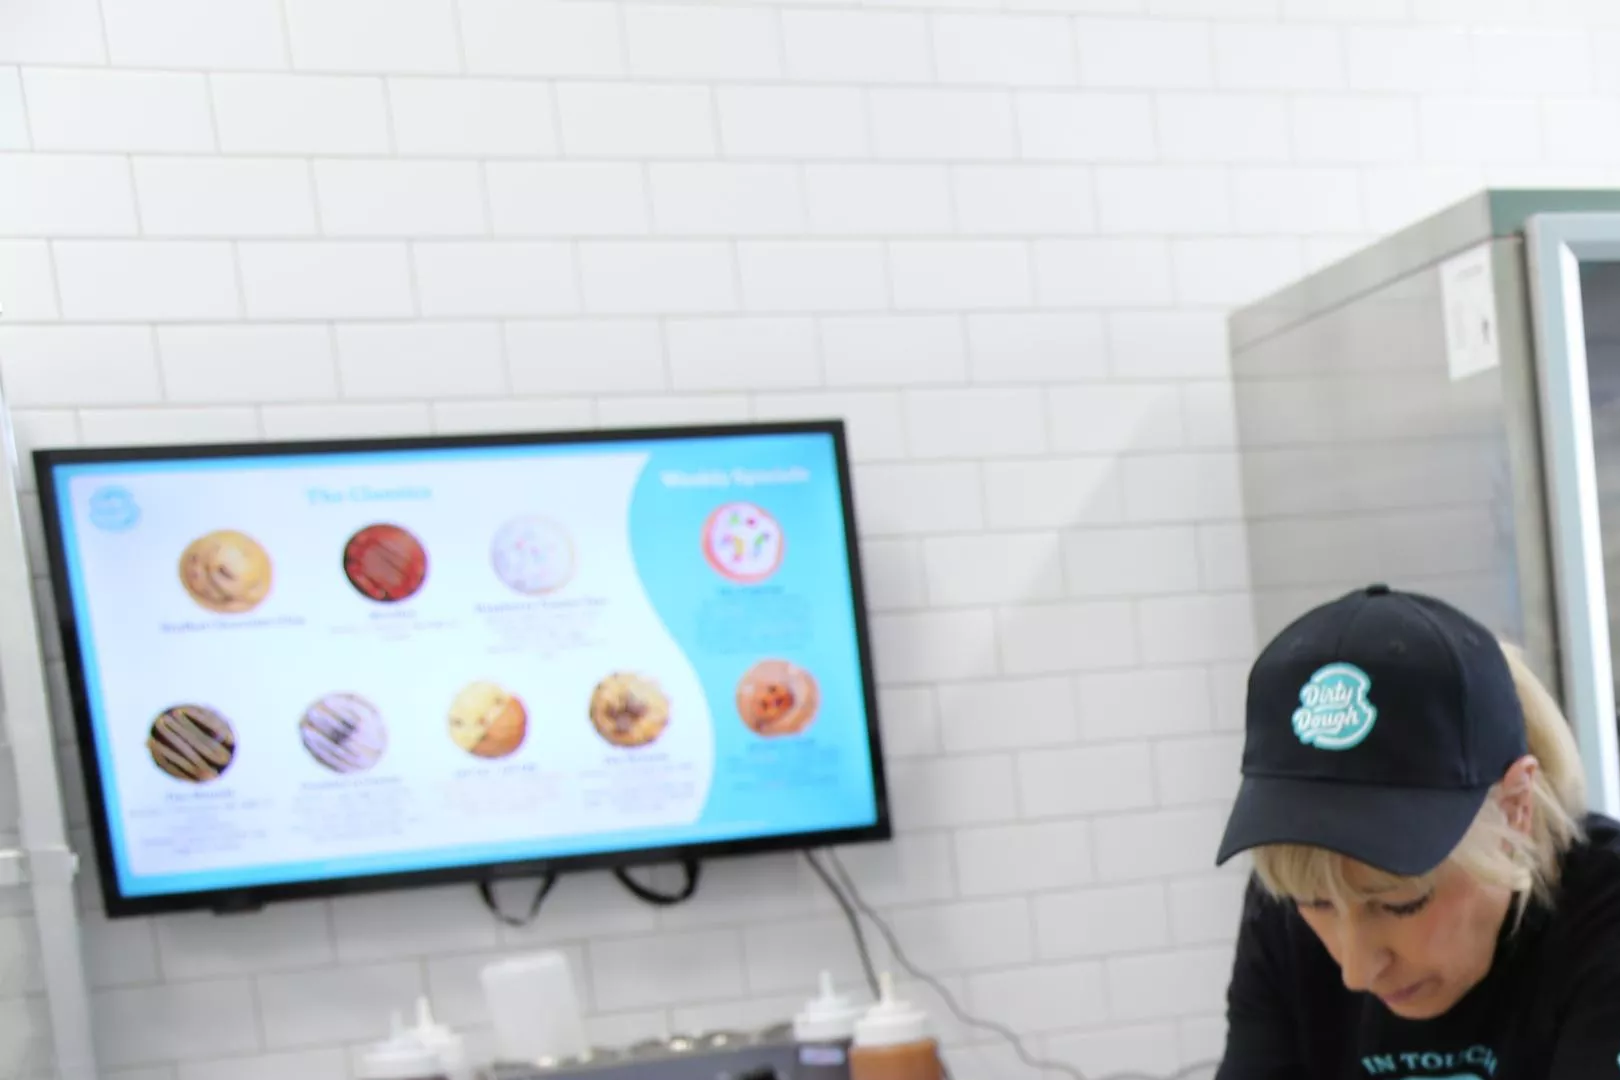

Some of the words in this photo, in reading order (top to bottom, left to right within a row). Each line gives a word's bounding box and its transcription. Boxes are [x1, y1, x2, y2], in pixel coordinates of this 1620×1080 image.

[1303, 680, 1354, 713] Dirty
[1297, 704, 1360, 738] Dough
[1361, 1052, 1396, 1076] IN
